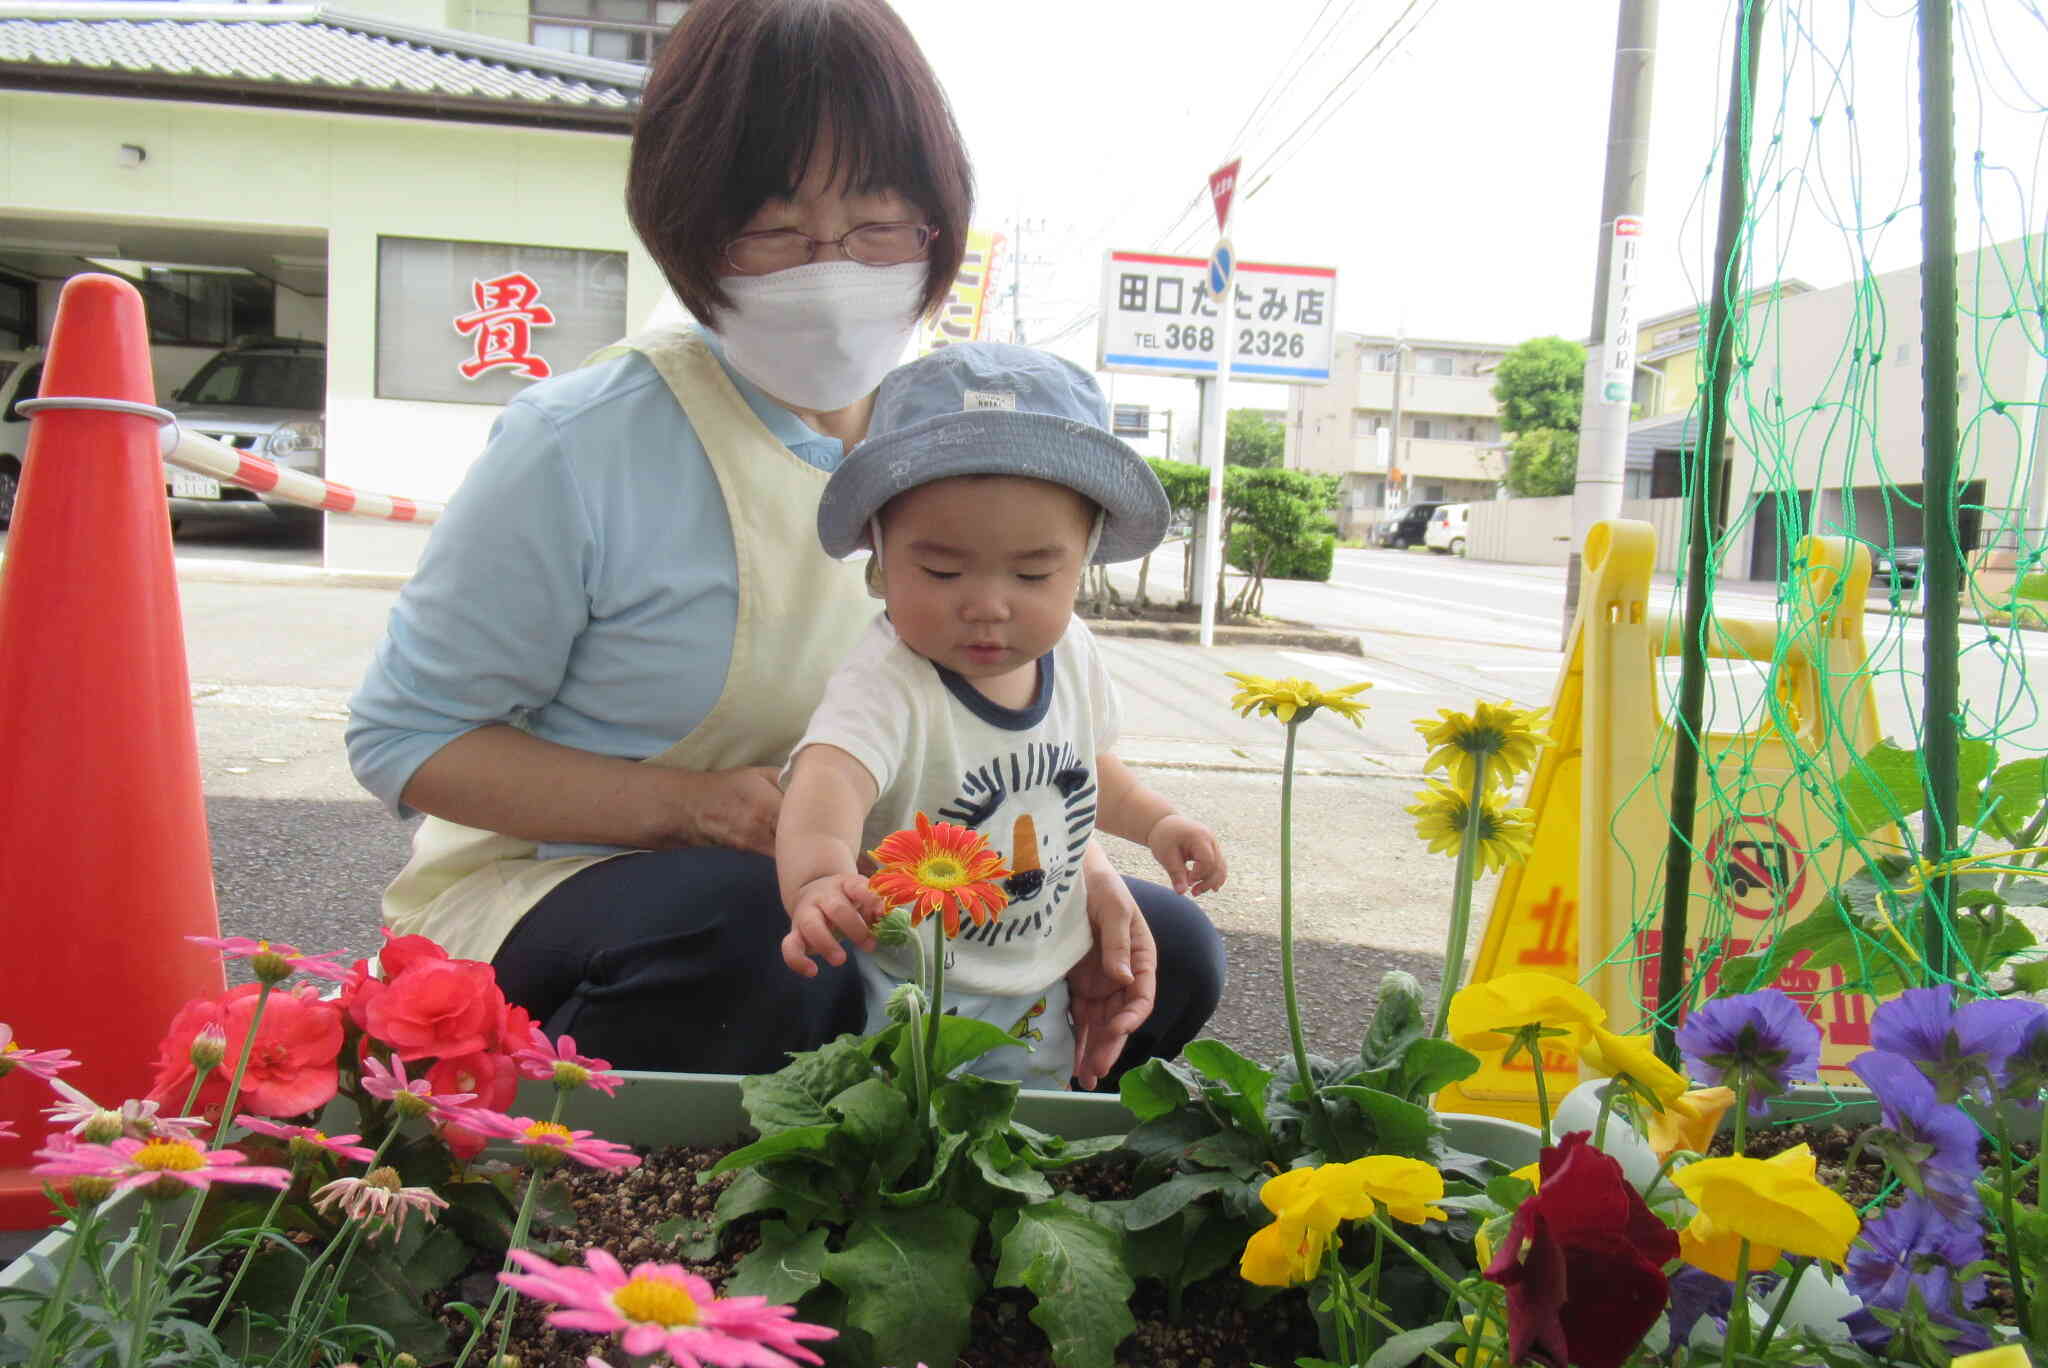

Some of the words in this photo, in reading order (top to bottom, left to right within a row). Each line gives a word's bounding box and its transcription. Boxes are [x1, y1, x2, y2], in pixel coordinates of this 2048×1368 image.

[453, 271, 555, 379] 畳
[1134, 332, 1160, 349] TEL
[1165, 323, 1214, 352] 368
[1238, 328, 1304, 358] 2326
